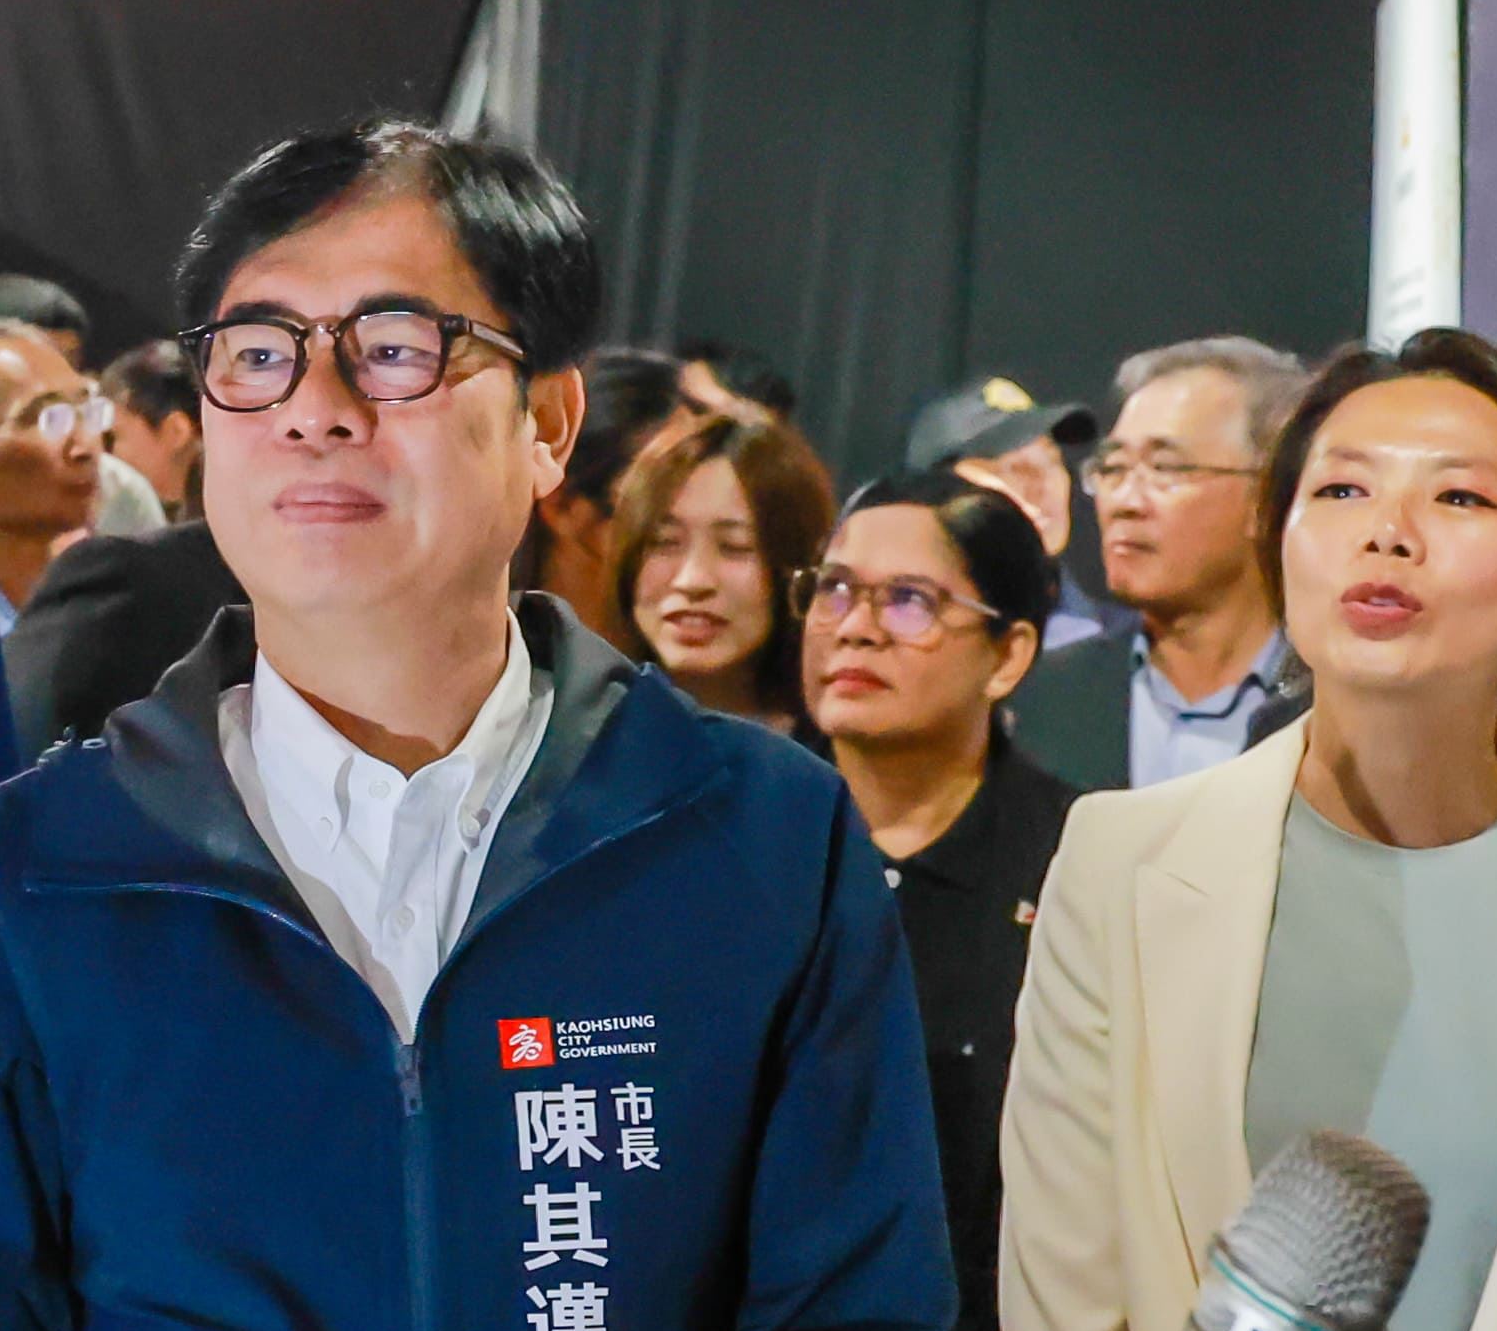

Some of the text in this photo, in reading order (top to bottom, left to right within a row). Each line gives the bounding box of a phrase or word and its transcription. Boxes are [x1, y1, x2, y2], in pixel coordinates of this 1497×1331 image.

[556, 1014, 656, 1035] KAOHSIUNG
[557, 1034, 592, 1047] CITY
[559, 1042, 657, 1060] GOVERNMENT
[609, 1081, 662, 1171] 市長
